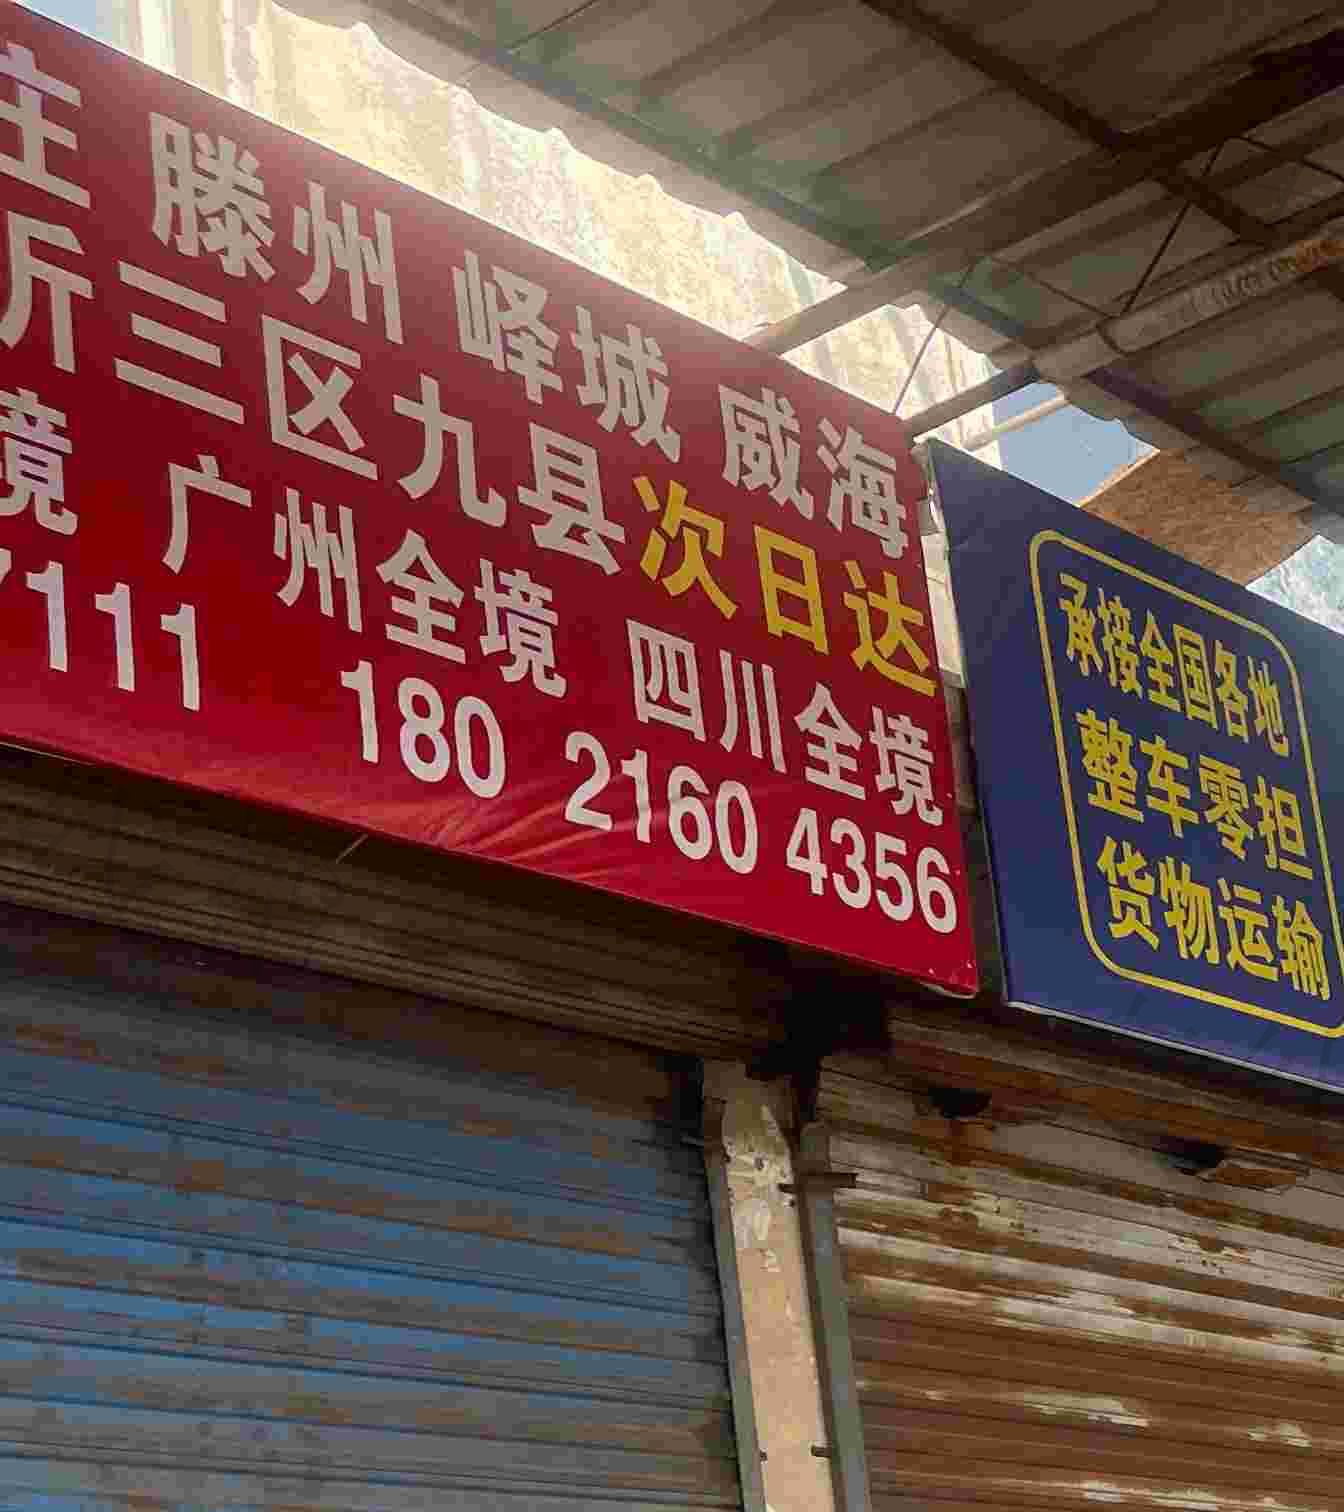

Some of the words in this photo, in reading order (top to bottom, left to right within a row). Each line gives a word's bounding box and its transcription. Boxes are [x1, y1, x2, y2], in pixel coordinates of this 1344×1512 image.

[148, 111, 405, 347] 滕州
[453, 249, 682, 464] 峄城
[718, 384, 912, 560] 威海
[161, 455, 568, 700] 广州全境
[626, 618, 945, 828] 四川全境
[1056, 574, 1290, 758] 承接全国各地
[341, 659, 507, 800] 180
[563, 733, 759, 875] 2160
[783, 808, 960, 935] 4356
[1076, 709, 1314, 881] 整车零担
[1096, 836, 1332, 1001] 货物运输
